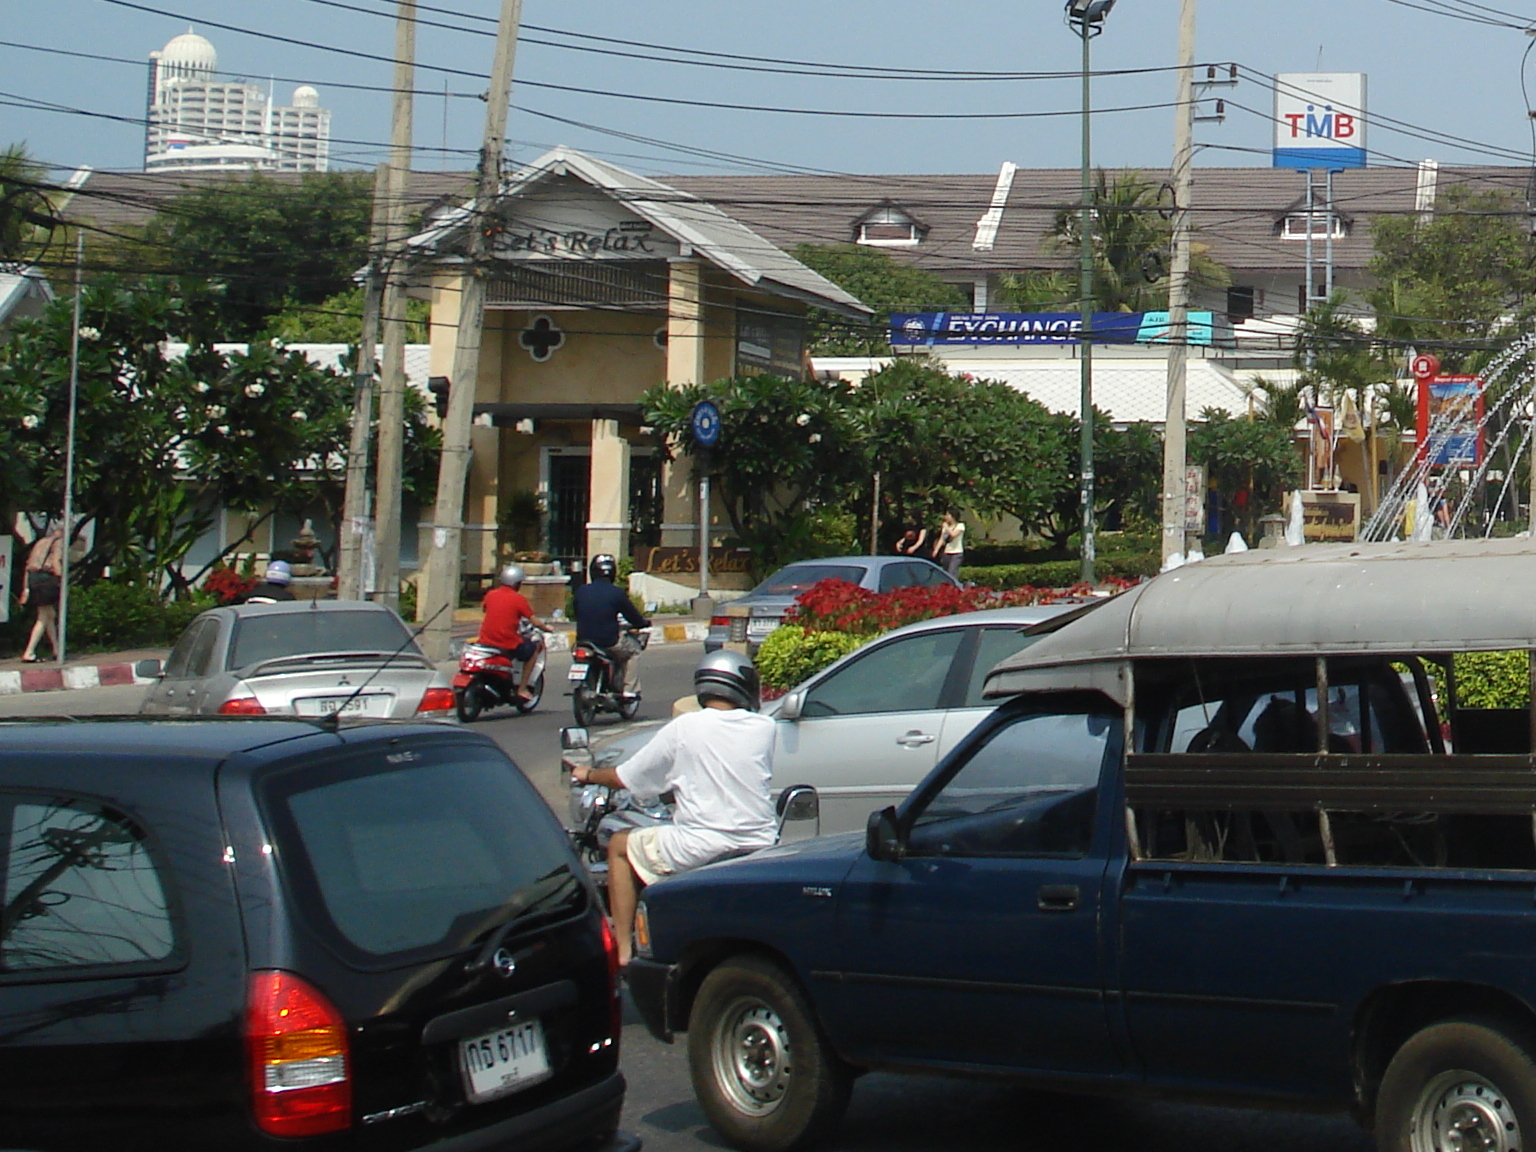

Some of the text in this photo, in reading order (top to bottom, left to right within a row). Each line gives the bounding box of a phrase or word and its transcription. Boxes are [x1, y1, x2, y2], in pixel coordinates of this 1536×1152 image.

[1284, 105, 1355, 138] TMB
[567, 227, 654, 253] Relax
[946, 320, 1083, 341] EXCHANGE
[646, 547, 750, 575] Let's Relax
[497, 1023, 536, 1063] 6717
